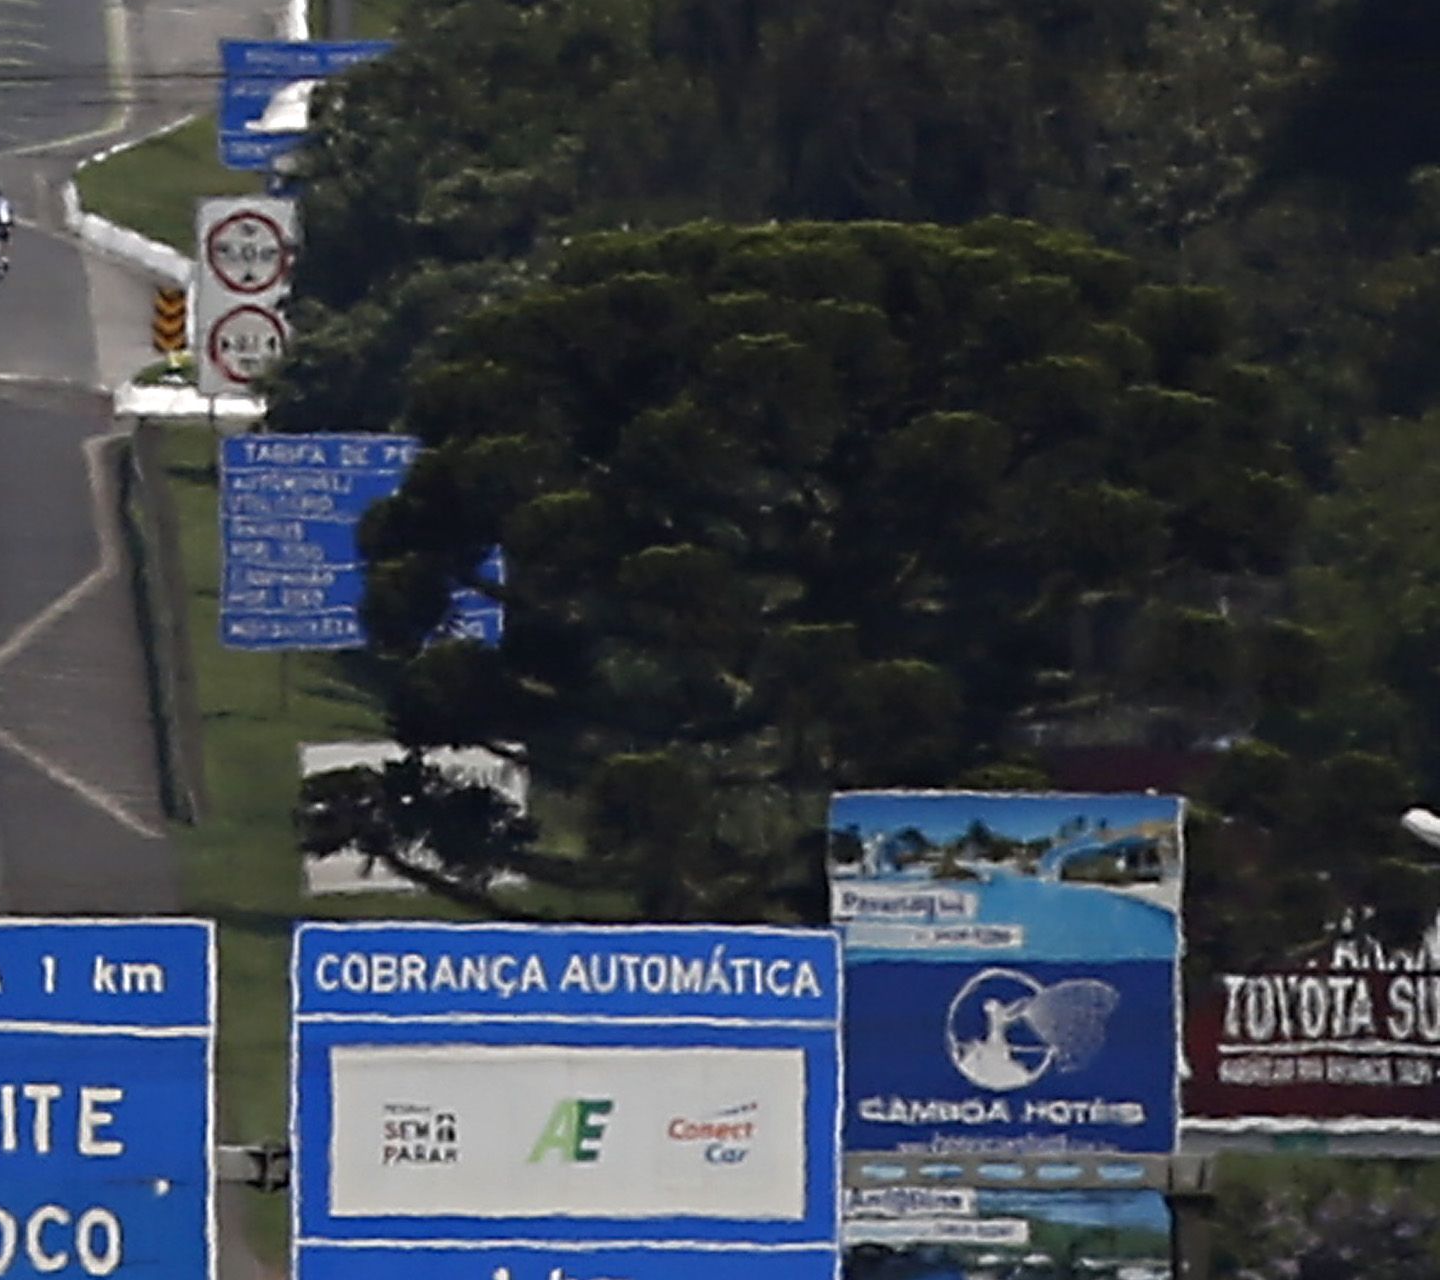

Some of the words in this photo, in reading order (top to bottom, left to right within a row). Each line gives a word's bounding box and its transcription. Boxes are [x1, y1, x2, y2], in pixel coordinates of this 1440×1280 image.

[41, 955, 56, 995] 1
[93, 955, 167, 995] km
[314, 952, 548, 999] COBRANÇA
[558, 945, 823, 999] AUTOMÁTICA
[1223, 974, 1375, 1040] TOYOTA
[704, 1144, 749, 1166] Car
